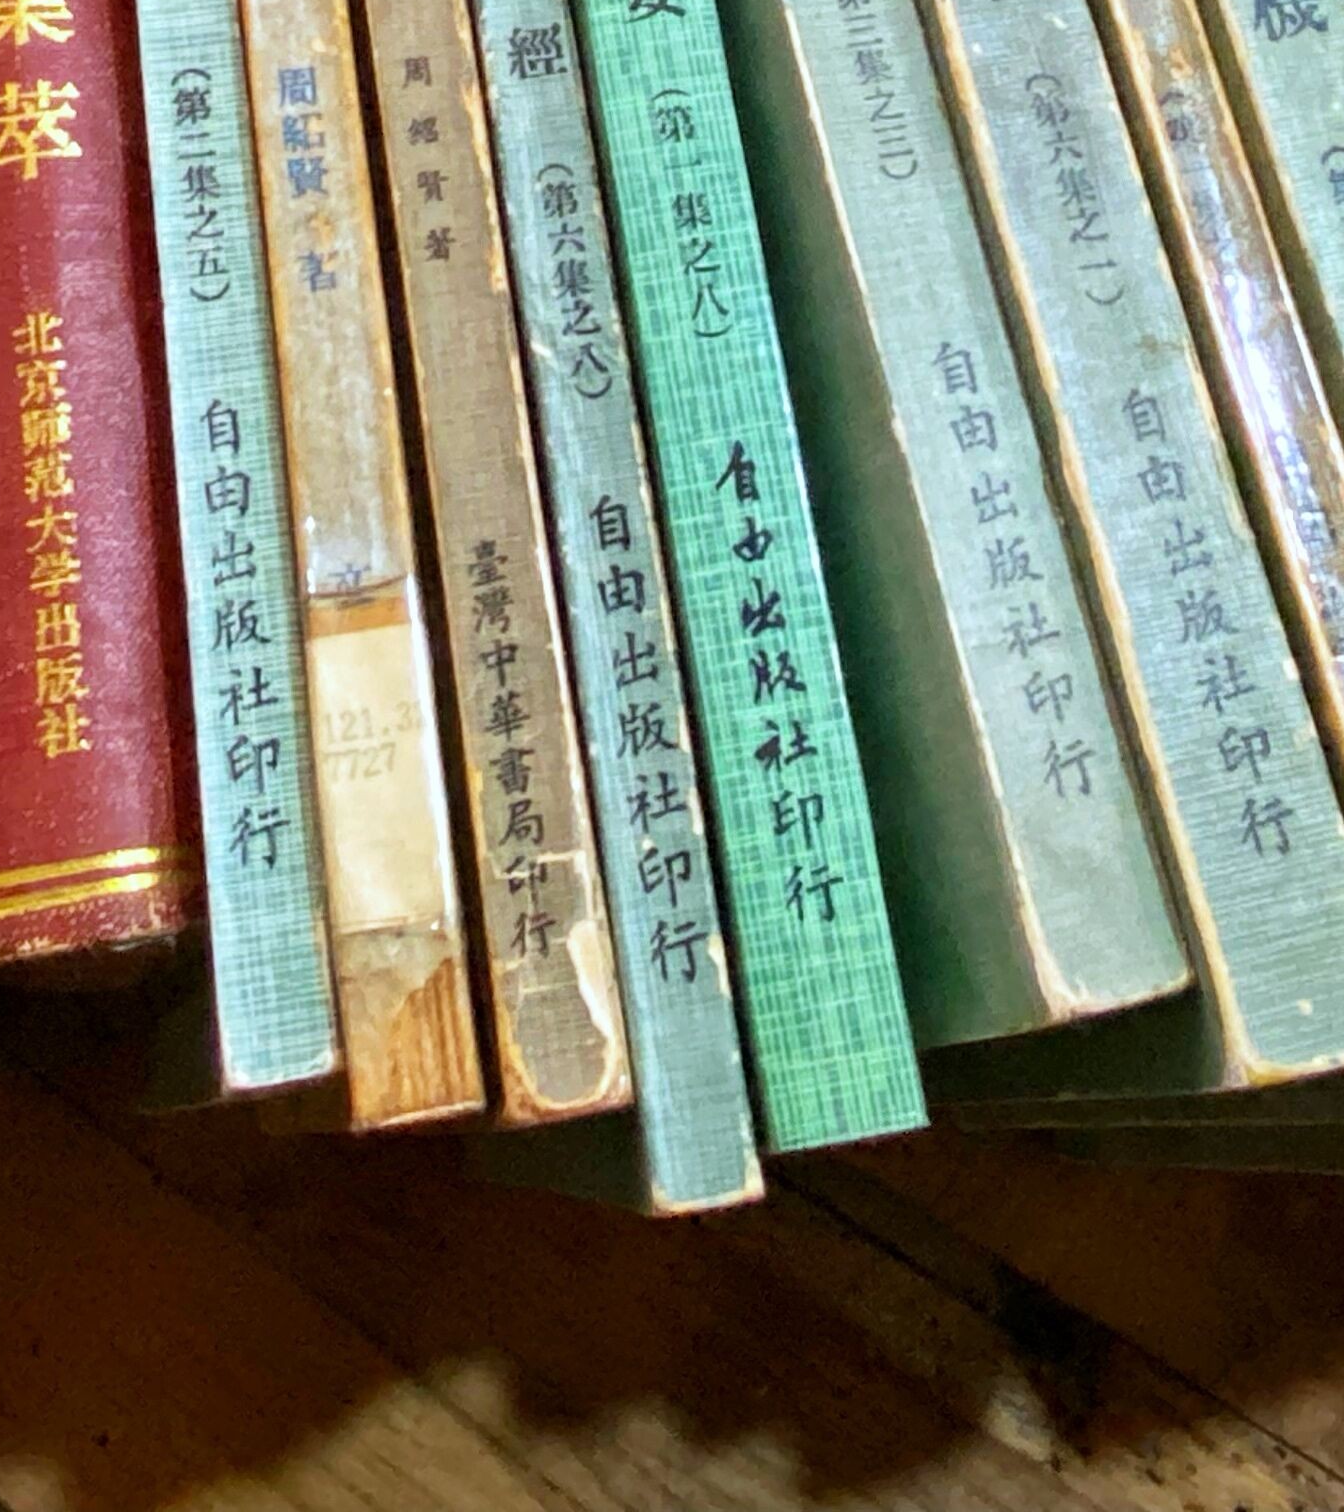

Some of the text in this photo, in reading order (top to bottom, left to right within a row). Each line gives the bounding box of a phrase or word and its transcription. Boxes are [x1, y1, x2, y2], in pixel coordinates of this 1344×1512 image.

[10, 312, 91, 759] 北京师范大学出版社
[197, 397, 292, 873] 自由出版社印行
[401, 56, 457, 264] 周紹賢著
[463, 539, 561, 959] 臺灣中華書局印行
[588, 494, 711, 985] 自由出版社印行
[715, 442, 846, 926] 自由出版社印行
[929, 341, 1098, 801] 自由出版社印行
[1120, 386, 1297, 859] 自由出版社印行
